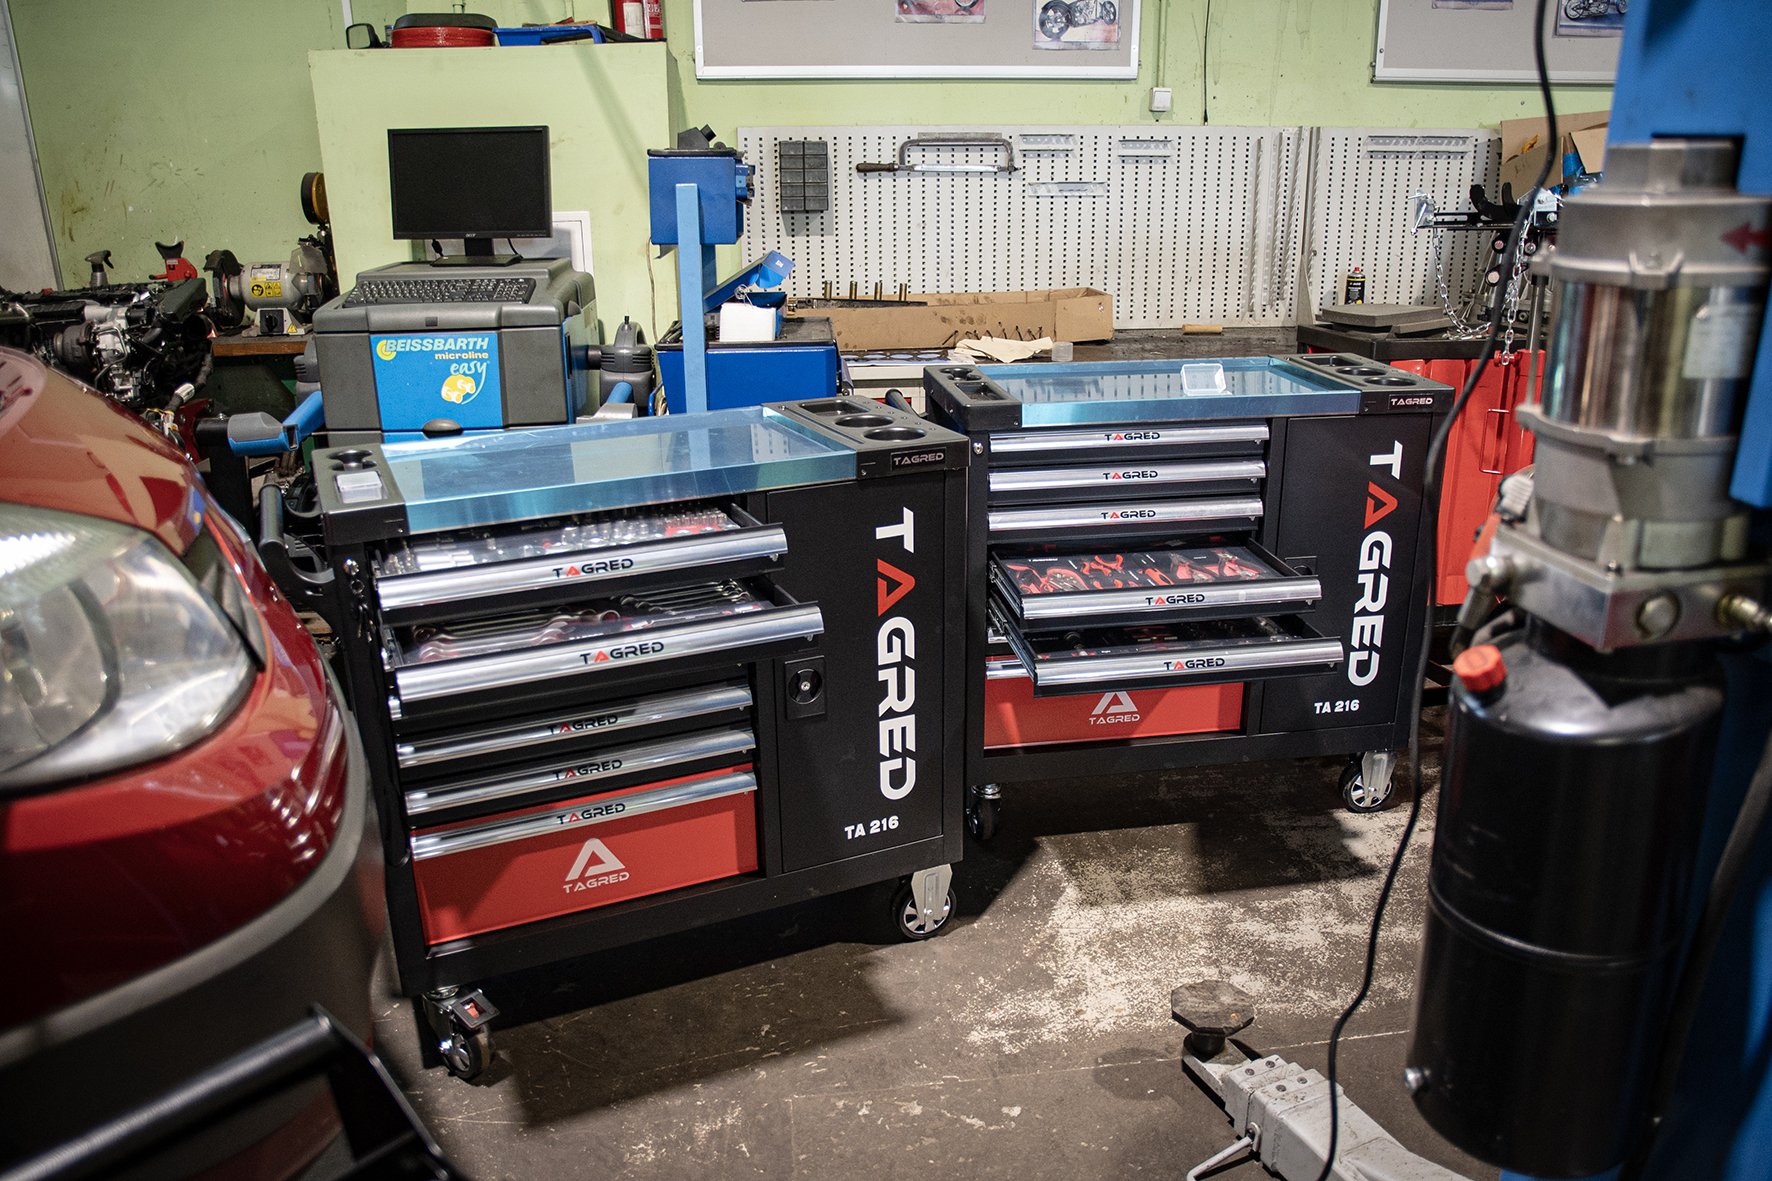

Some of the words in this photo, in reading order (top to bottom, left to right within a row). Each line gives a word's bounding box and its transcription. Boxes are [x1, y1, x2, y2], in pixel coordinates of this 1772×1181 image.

[386, 337, 489, 352] BEISSBARTH
[434, 351, 489, 360] microline
[450, 360, 488, 383] easy
[1391, 397, 1433, 406] TAGRED
[1104, 431, 1160, 442] TAGRED
[893, 452, 945, 466] TAGRED
[1102, 469, 1158, 480] TAGRED
[1101, 509, 1156, 520] TAGRED
[552, 557, 634, 579] TAGRED
[1347, 440, 1403, 687] TAGRED
[1146, 593, 1205, 606] TAGRED
[580, 640, 664, 665] TAGRED
[875, 506, 916, 801] TAGRED
[1163, 657, 1225, 671] TAGRED
[1314, 701, 1331, 715] TA
[1334, 699, 1360, 712] 216
[547, 714, 618, 735] TAGRED
[1088, 713, 1140, 725] TAGRED
[553, 759, 623, 781] TAGRED
[557, 803, 626, 825] TAGRED
[844, 823, 866, 840] TA
[869, 815, 899, 835] 216
[562, 871, 630, 894] TAGRED
